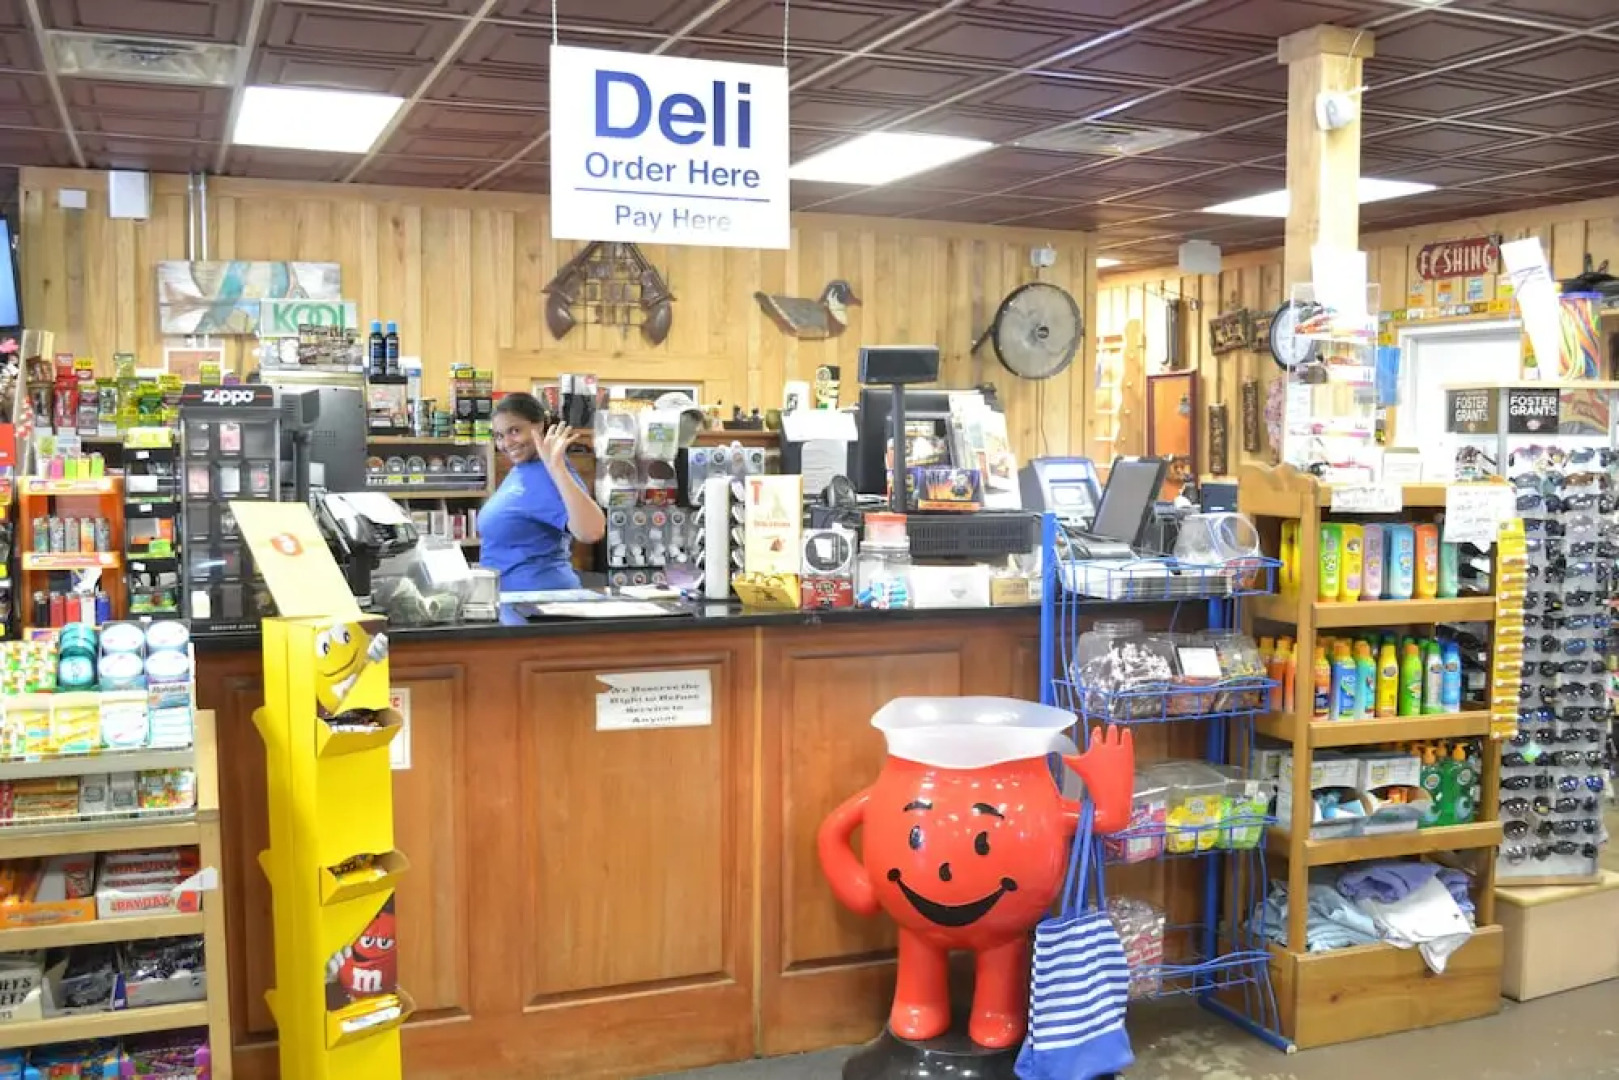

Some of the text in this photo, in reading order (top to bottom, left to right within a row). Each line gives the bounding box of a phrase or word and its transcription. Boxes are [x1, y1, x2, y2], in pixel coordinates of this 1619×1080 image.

[595, 69, 751, 149] Deli
[585, 151, 761, 188] Order Here
[615, 204, 732, 233] Pay Here
[1454, 396, 1489, 409] FOSTER
[1509, 395, 1557, 407] FOSTER
[1454, 409, 1489, 422] GRANTS
[1509, 406, 1557, 417] GRANTS
